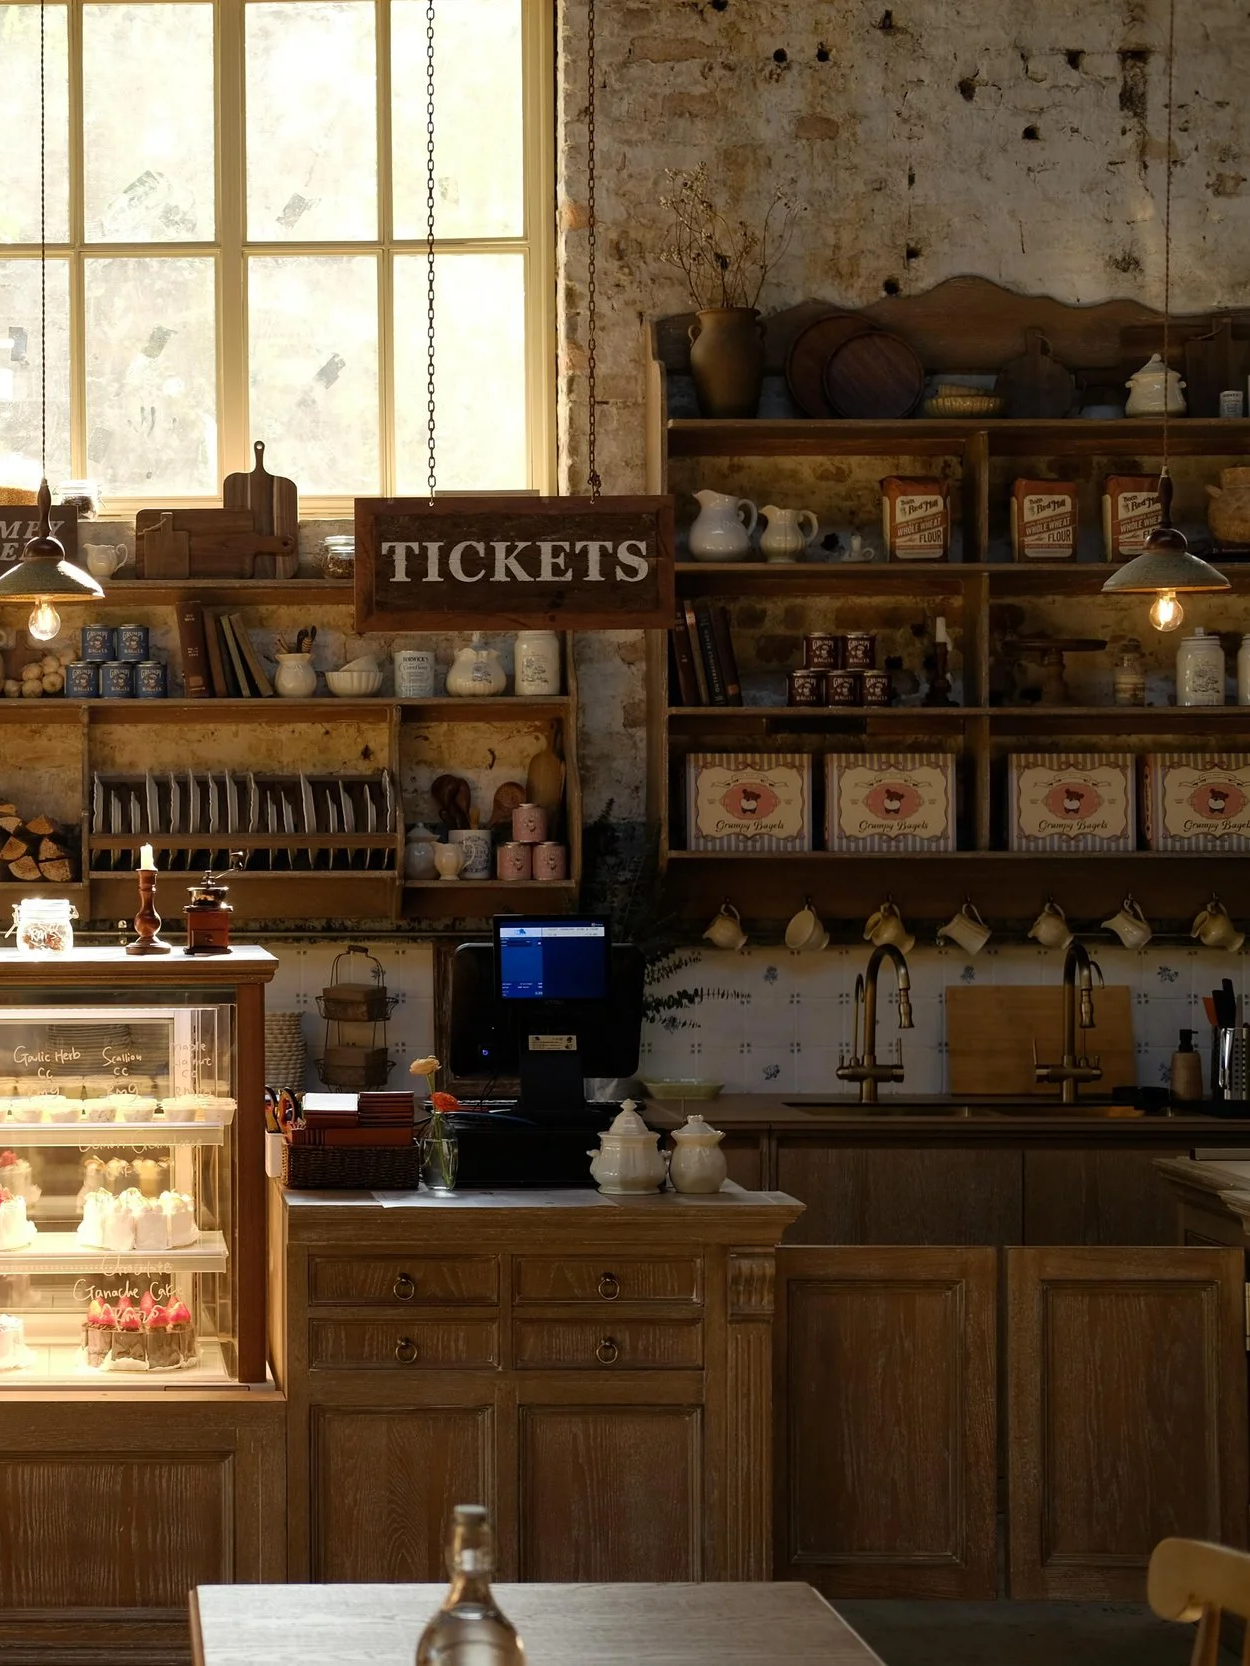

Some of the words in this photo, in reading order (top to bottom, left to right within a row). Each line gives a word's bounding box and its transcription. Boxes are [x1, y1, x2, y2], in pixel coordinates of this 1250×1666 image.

[897, 523, 919, 536] WHOLE
[920, 517, 941, 531] WHEAT
[1026, 522, 1048, 535] WHOLE
[1049, 517, 1070, 529] WHEAT
[1120, 520, 1143, 533] WHOLE
[919, 530, 942, 543] FLOUR
[1047, 529, 1071, 542] FLOUR
[381, 540, 649, 582] TICKETS
[715, 820, 750, 833] Grumpy
[753, 820, 784, 832] Bagels
[858, 820, 894, 833] Grumpy
[897, 820, 928, 832] Bagels
[1038, 820, 1073, 833] Grumpy
[1076, 820, 1108, 832] Bagels
[1183, 820, 1218, 833] Grumpy
[13, 1045, 51, 1067] Garlic
[55, 1046, 82, 1065] Herb
[102, 1046, 143, 1068] Scallion
[37, 1067, 54, 1079] CC
[113, 1067, 130, 1077] CC
[72, 1279, 140, 1303] Ganache
[149, 1281, 184, 1302] Cake
